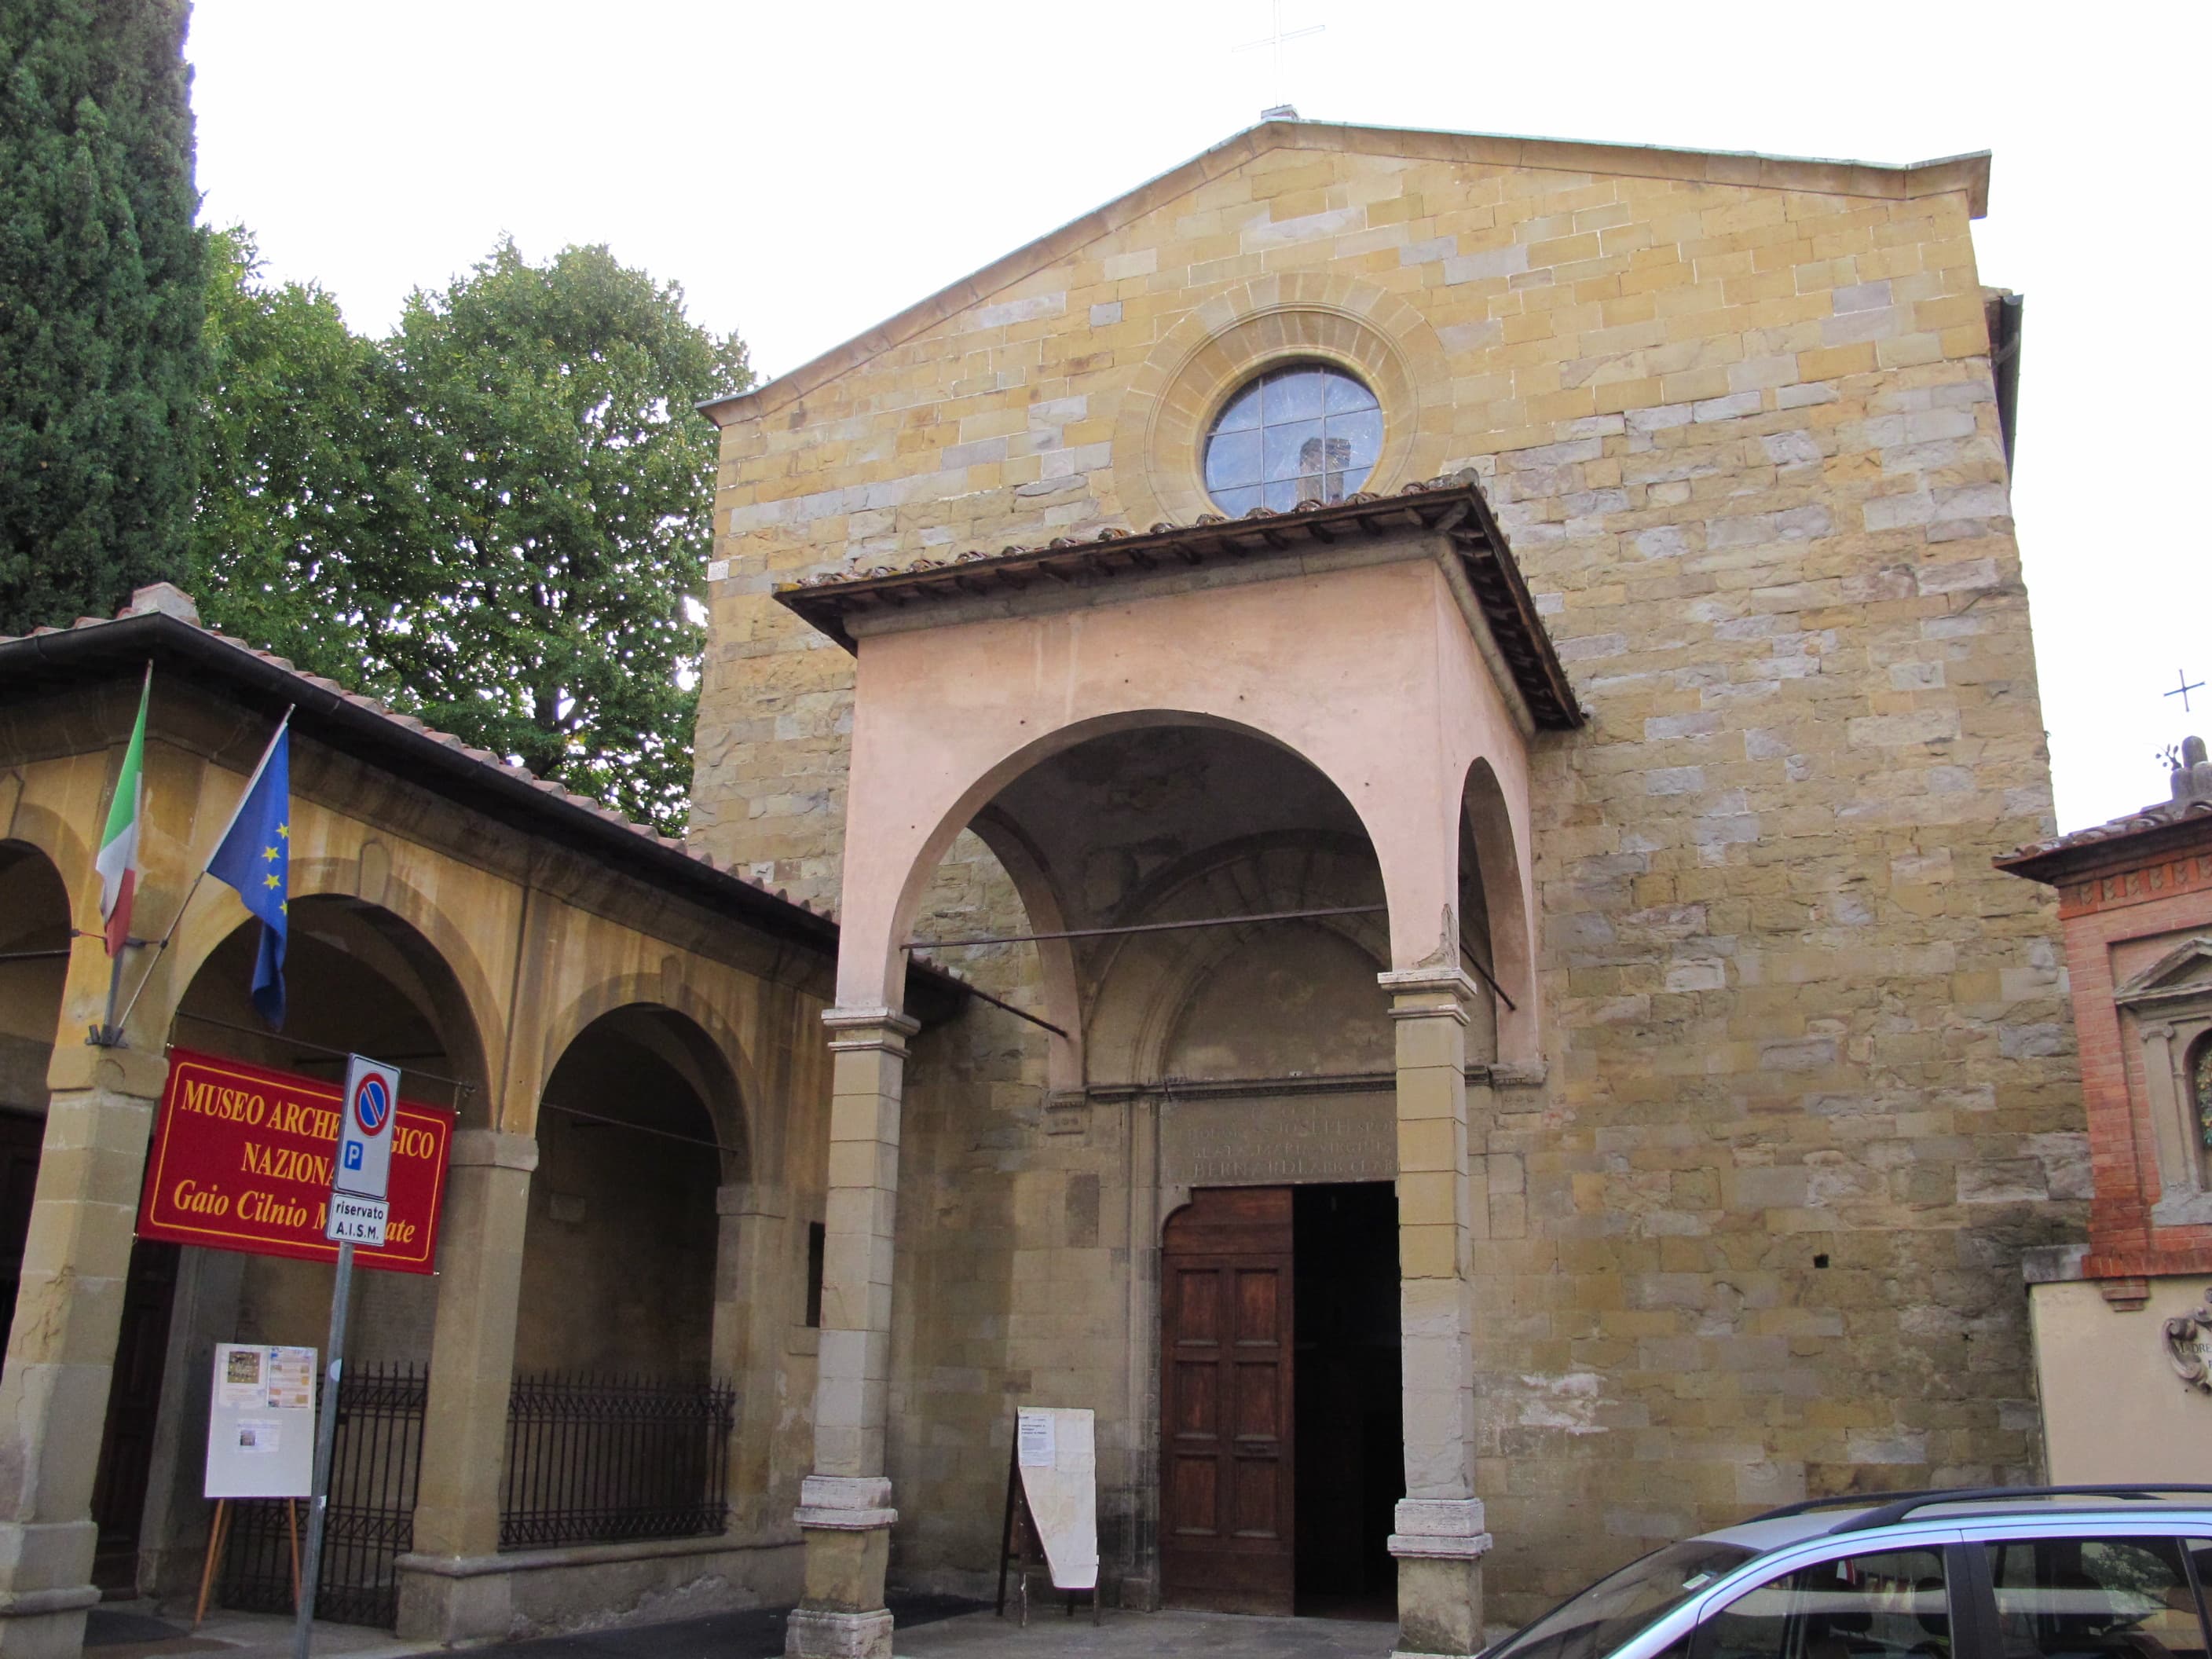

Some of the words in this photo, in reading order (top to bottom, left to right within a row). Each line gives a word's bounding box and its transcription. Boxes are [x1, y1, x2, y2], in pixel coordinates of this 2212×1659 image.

[181, 1079, 266, 1125] MUSEO
[266, 1100, 435, 1159] ARCHEGICO
[347, 1144, 360, 1166] P
[174, 1180, 230, 1217] Gaio
[237, 1190, 308, 1227] Cilnio
[335, 1200, 384, 1220] riservato
[336, 1221, 379, 1240] A.I.S.M.
